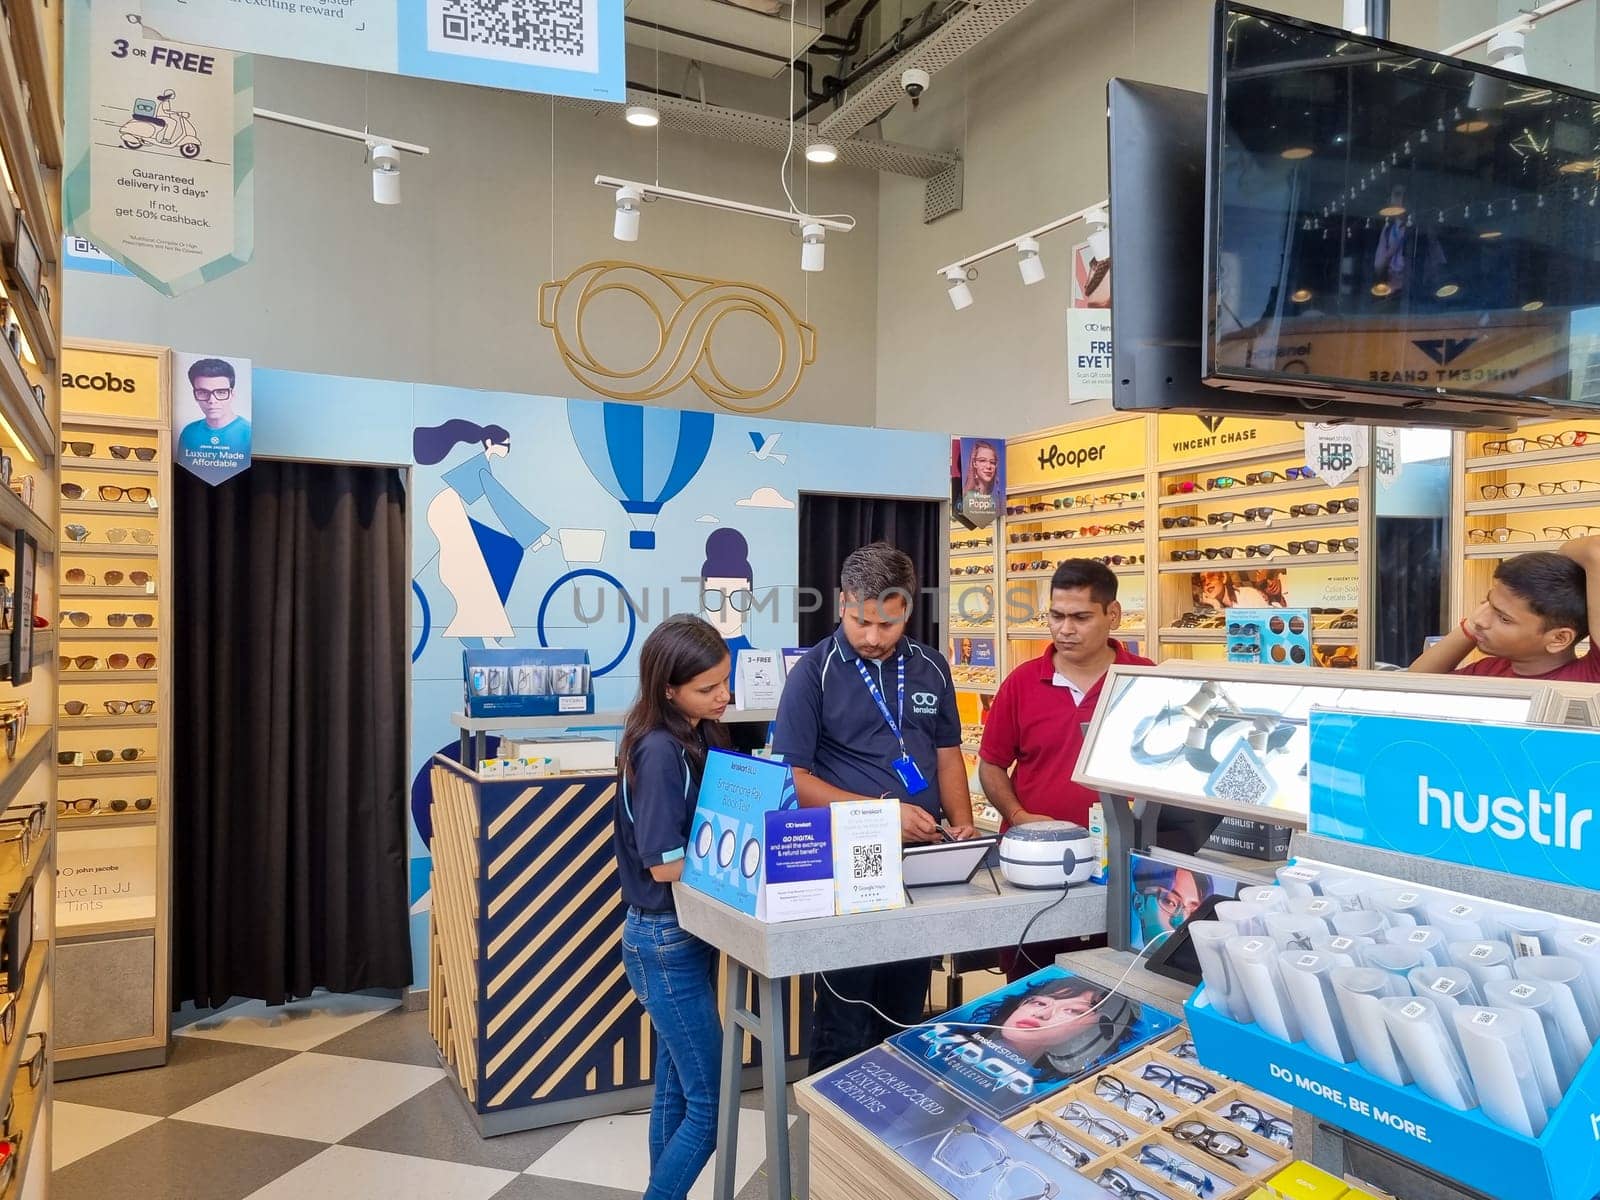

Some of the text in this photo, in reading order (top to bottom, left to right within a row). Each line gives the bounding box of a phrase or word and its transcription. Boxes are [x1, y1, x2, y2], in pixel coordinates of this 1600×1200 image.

[300, 4, 343, 18] reward
[111, 38, 215, 75] 3 OR FREE
[132, 168, 195, 186] Guaranteed
[117, 178, 158, 192] delivery
[161, 183, 171, 194] in
[172, 184, 180, 195] 3
[149, 200, 178, 213] If not,
[115, 208, 211, 228] get 50% cashback.
[1078, 356, 1102, 368] EYE
[1173, 429, 1257, 453] VINCENT CHASE
[185, 449, 245, 460] Luxury Made
[1038, 445, 1106, 471] Hooper
[1320, 443, 1352, 457] HIP
[192, 458, 238, 468] Affordable
[1320, 457, 1353, 471] HOP
[1418, 776, 1593, 850] hustlr
[792, 834, 814, 842] DIGITAL
[1209, 835, 1255, 850] MY WISHLIST
[76, 866, 94, 874] john
[93, 884, 107, 895] In
[65, 899, 104, 912] Tints
[947, 1058, 993, 1089] COLLECTION
[845, 1069, 891, 1097] LUXURY
[861, 1061, 945, 1115] COLOR BLOCKED
[831, 1079, 886, 1113] ACETATES
[1269, 1063, 1433, 1144] DO MORE, BE MORE.
